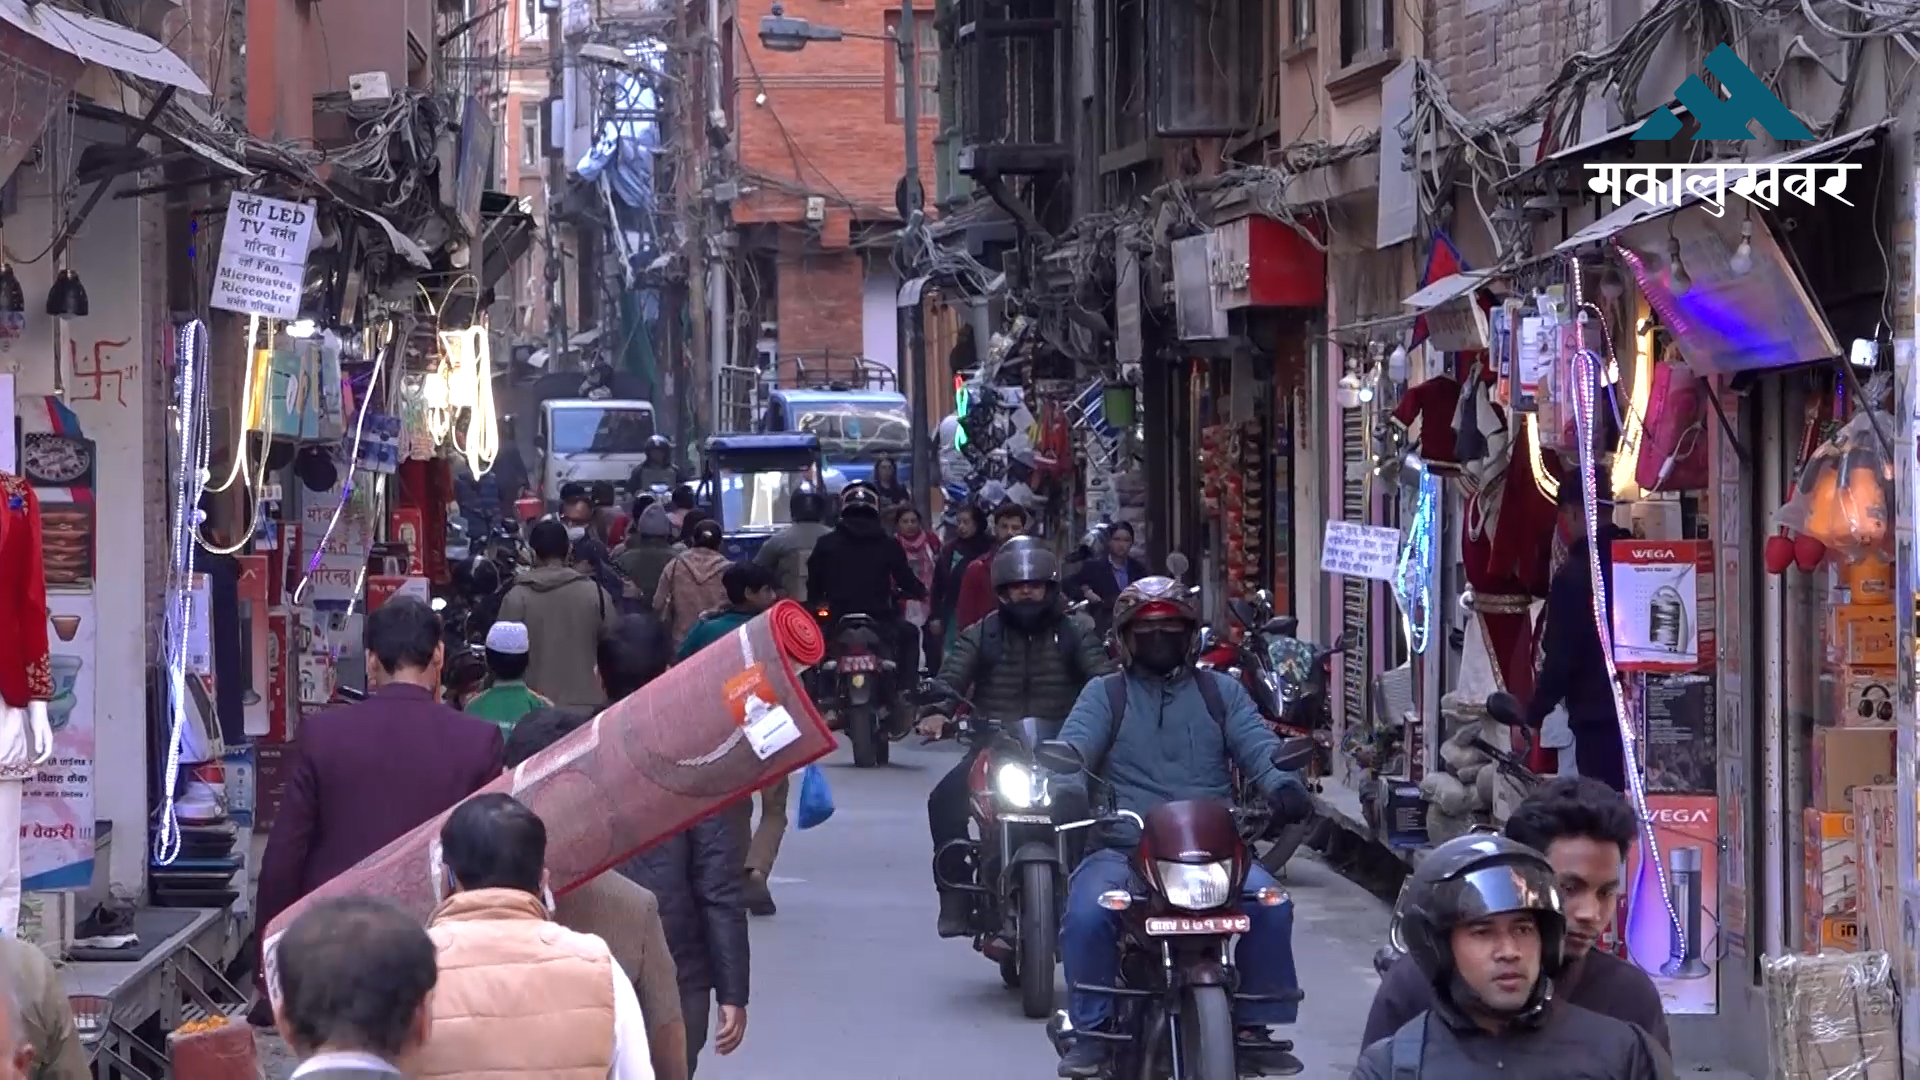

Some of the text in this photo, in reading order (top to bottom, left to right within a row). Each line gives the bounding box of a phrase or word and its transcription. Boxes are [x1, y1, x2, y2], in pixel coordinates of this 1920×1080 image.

[237, 199, 306, 225] यहाँ LED
[240, 218, 265, 234] TV
[257, 260, 283, 276] Fan,
[220, 267, 296, 292] Microwaves,
[221, 281, 292, 303] Ricecooker
[1631, 549, 1675, 559] WEGA
